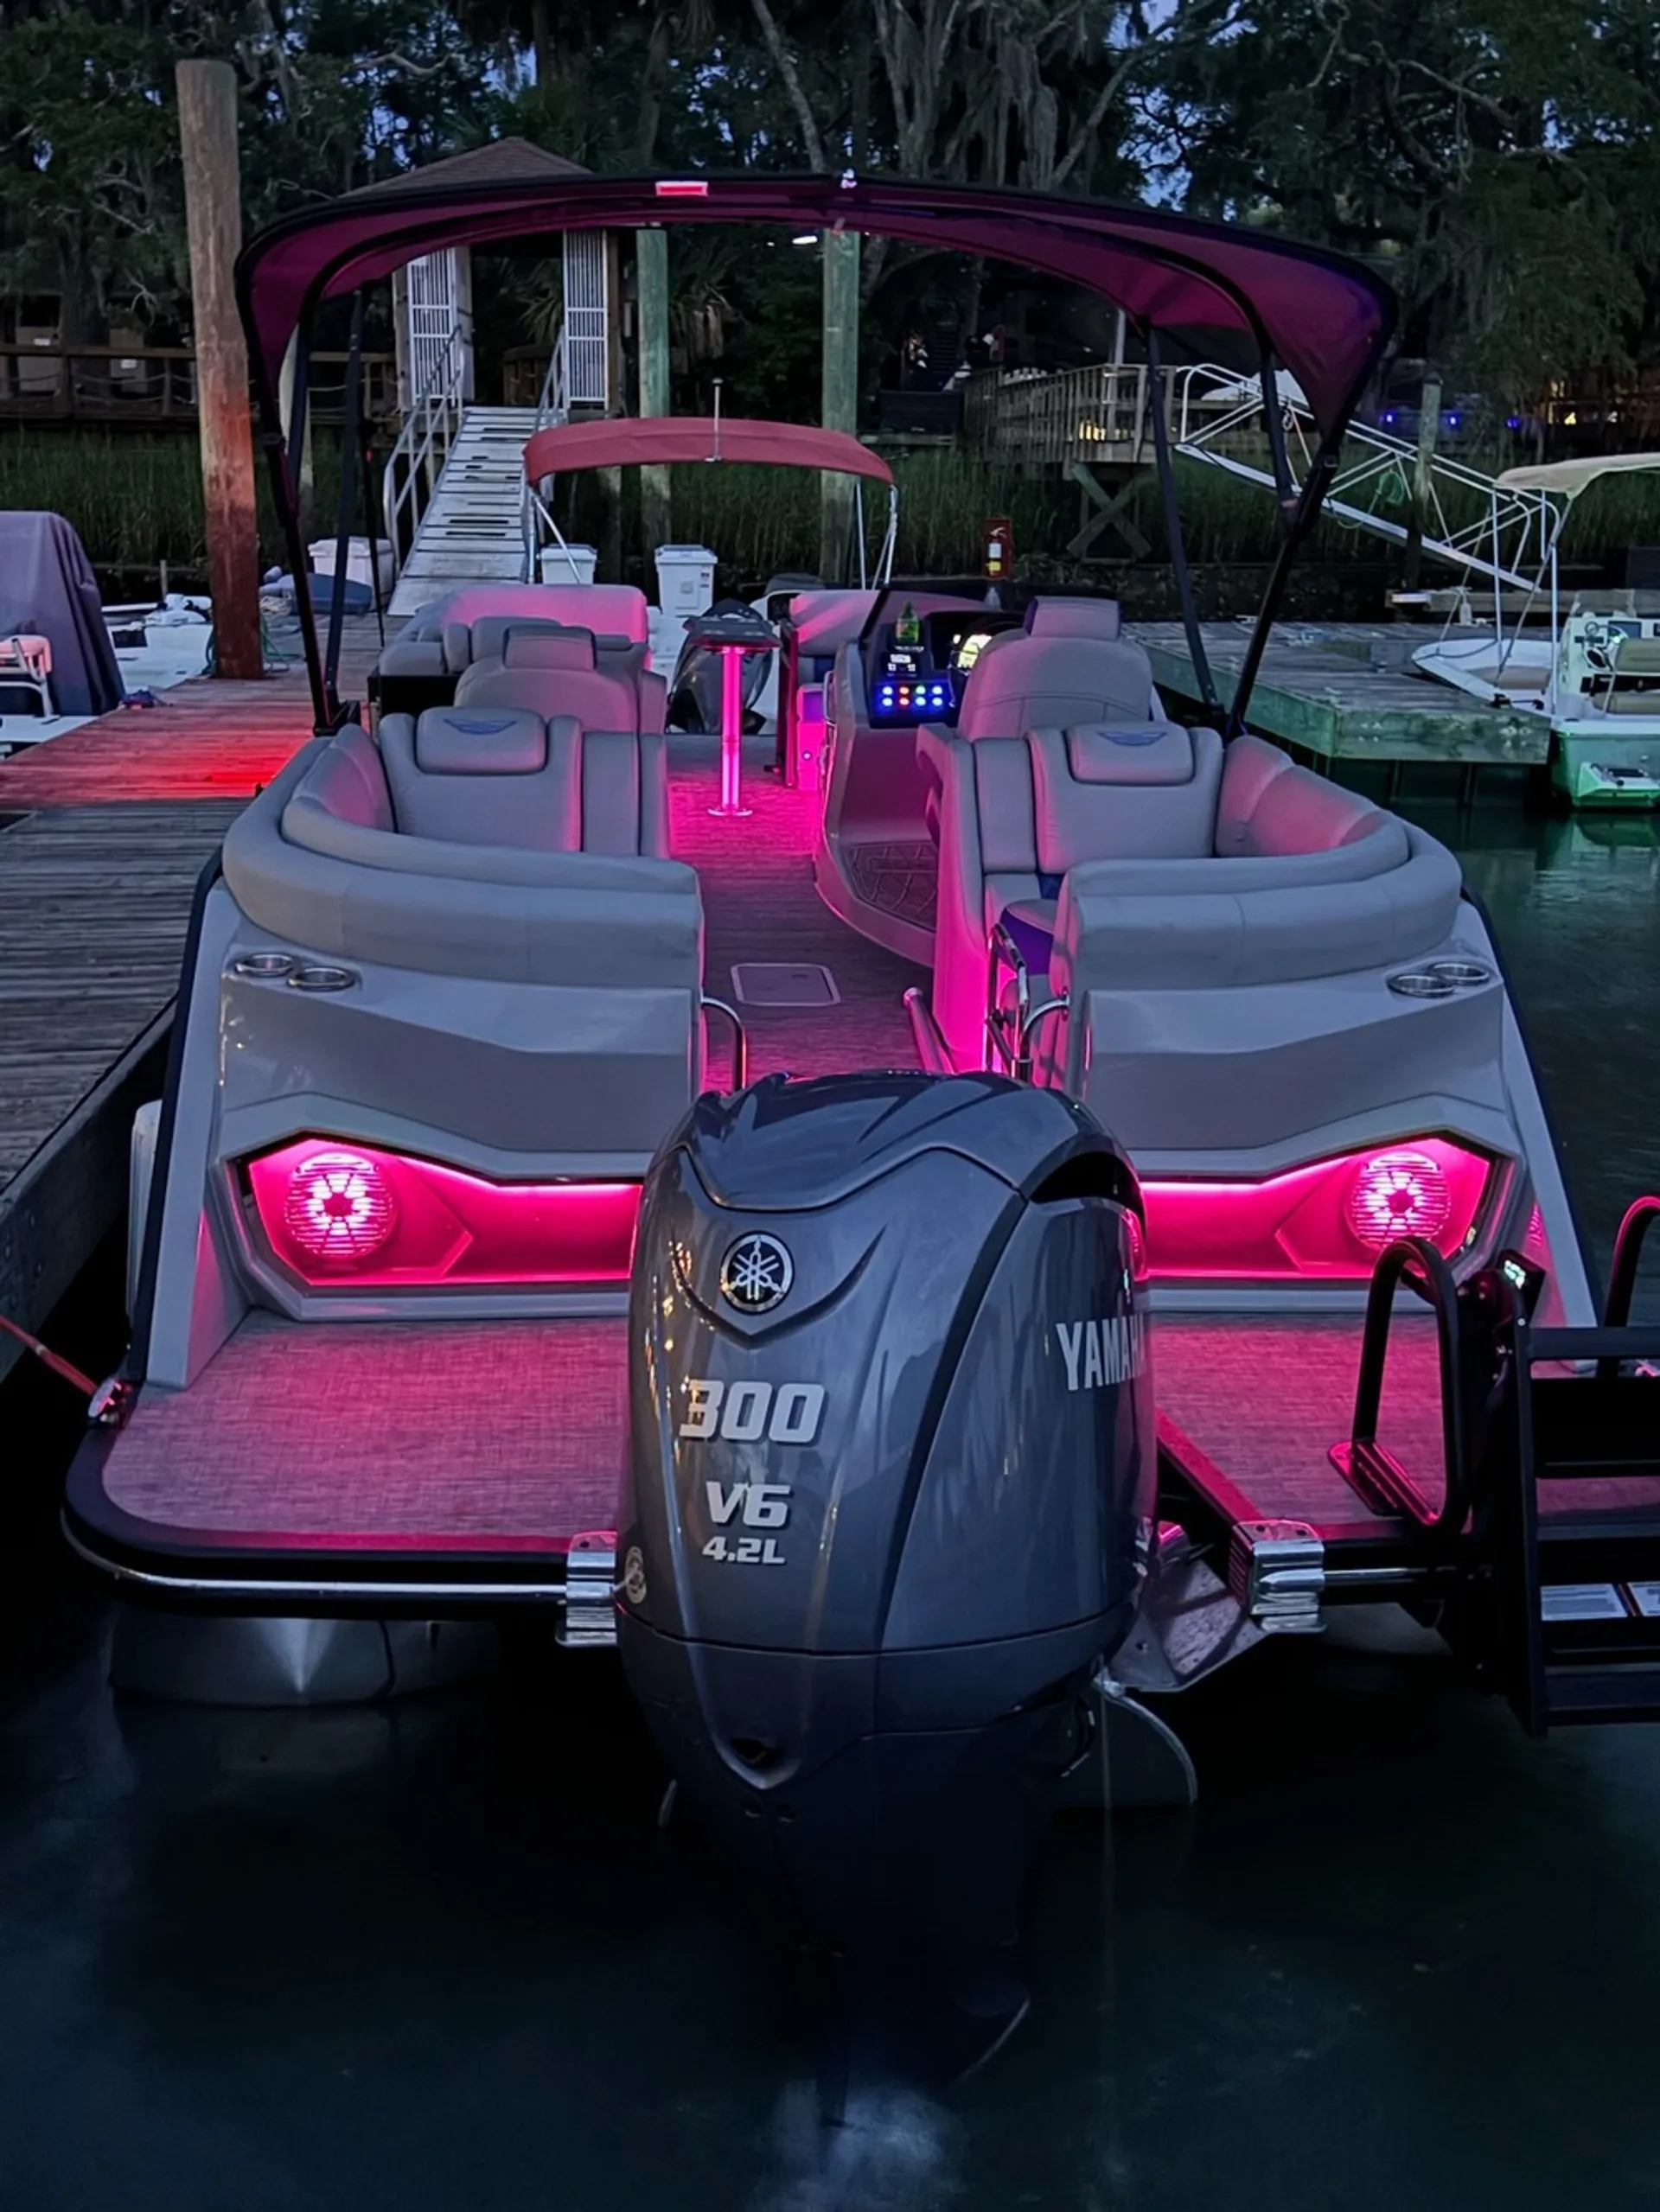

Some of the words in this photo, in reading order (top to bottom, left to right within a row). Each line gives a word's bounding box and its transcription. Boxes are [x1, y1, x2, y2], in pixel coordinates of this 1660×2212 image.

[679, 1379, 825, 1443] 300
[705, 1481, 791, 1527] V6
[702, 1536, 786, 1564] 4.2L
